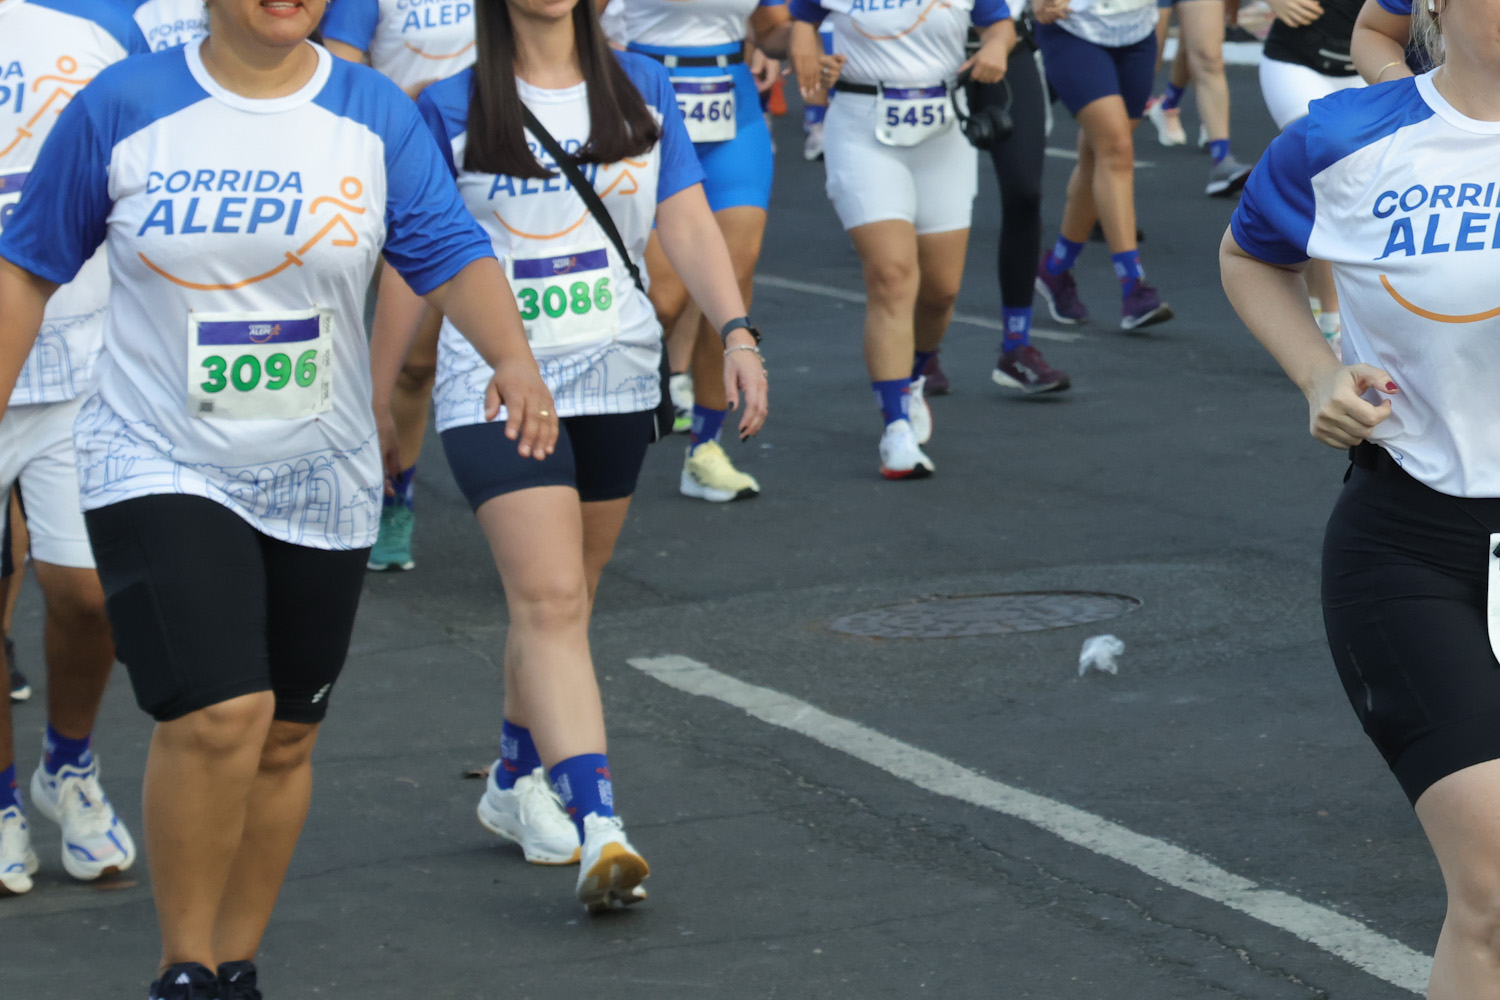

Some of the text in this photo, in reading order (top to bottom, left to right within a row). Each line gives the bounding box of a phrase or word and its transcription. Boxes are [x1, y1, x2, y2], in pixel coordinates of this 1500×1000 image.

[886, 104, 946, 126] 5451
[146, 169, 303, 195] CORRIDA
[136, 197, 303, 237] ALEPI
[517, 277, 612, 321] 3086
[200, 349, 318, 393] 3096
